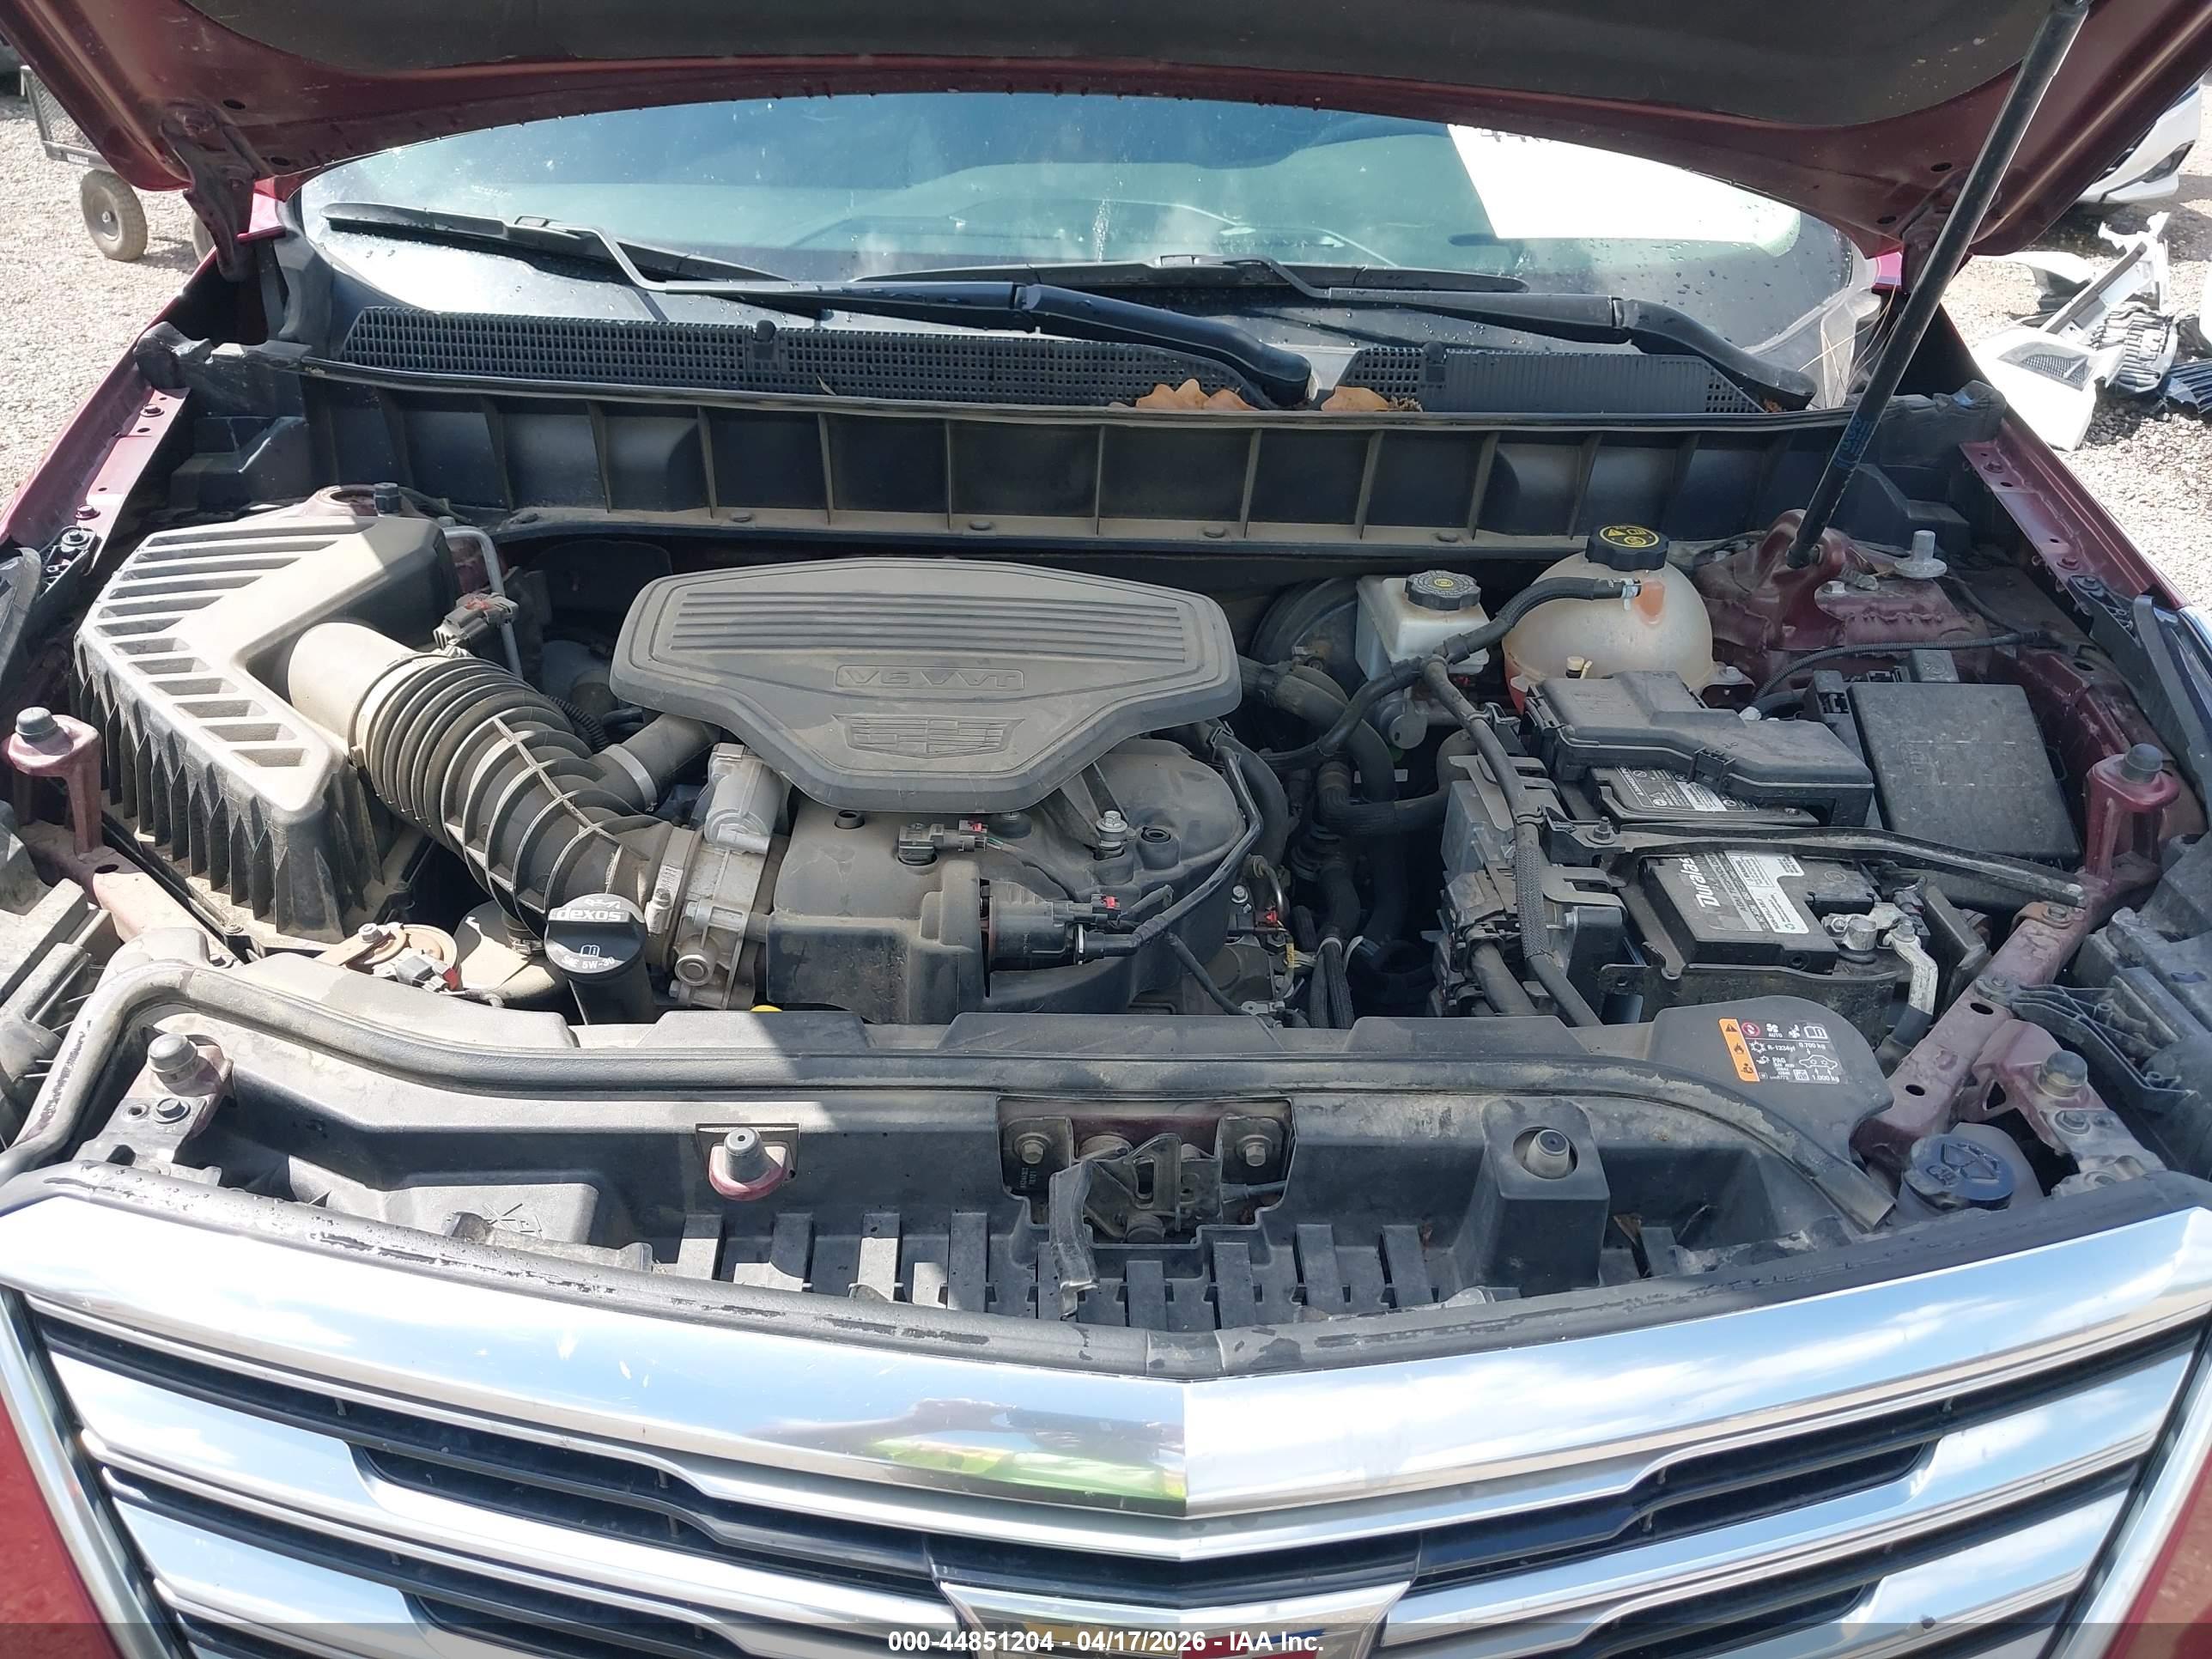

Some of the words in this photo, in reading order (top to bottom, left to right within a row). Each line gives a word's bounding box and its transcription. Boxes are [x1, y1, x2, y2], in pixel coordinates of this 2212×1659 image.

[846, 670, 910, 684] V6
[920, 671, 1018, 688] VVT
[1679, 857, 1722, 908] Duralas
[555, 907, 625, 921] dexos
[561, 954, 580, 968] SAE
[582, 956, 615, 969] 5W-30
[1811, 1073, 1831, 1082] 1.000
